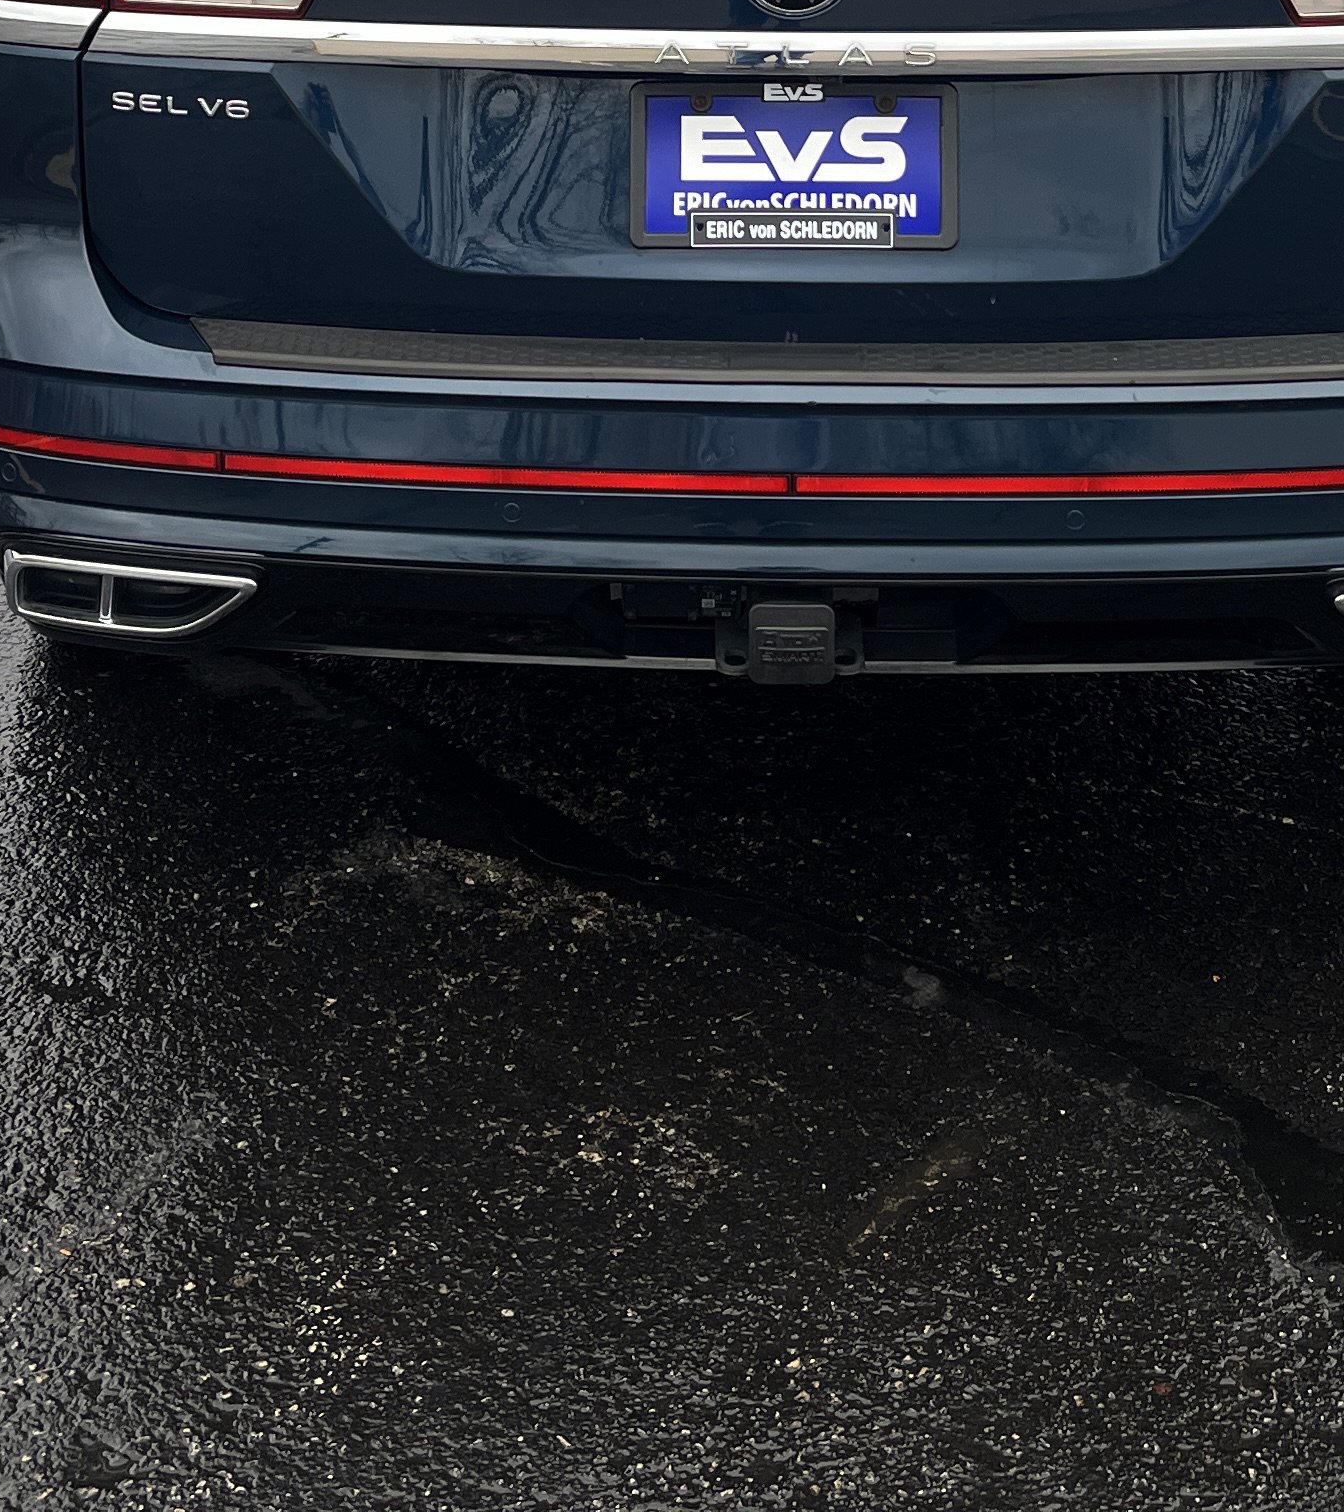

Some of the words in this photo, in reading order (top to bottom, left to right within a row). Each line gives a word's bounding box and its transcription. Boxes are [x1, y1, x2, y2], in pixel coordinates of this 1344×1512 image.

[655, 40, 937, 68] ATLAS
[112, 91, 188, 116] SEL
[197, 97, 250, 119] V6
[706, 220, 745, 239] ERIC
[749, 224, 776, 239] von
[780, 220, 878, 240] SCHLEDORN
